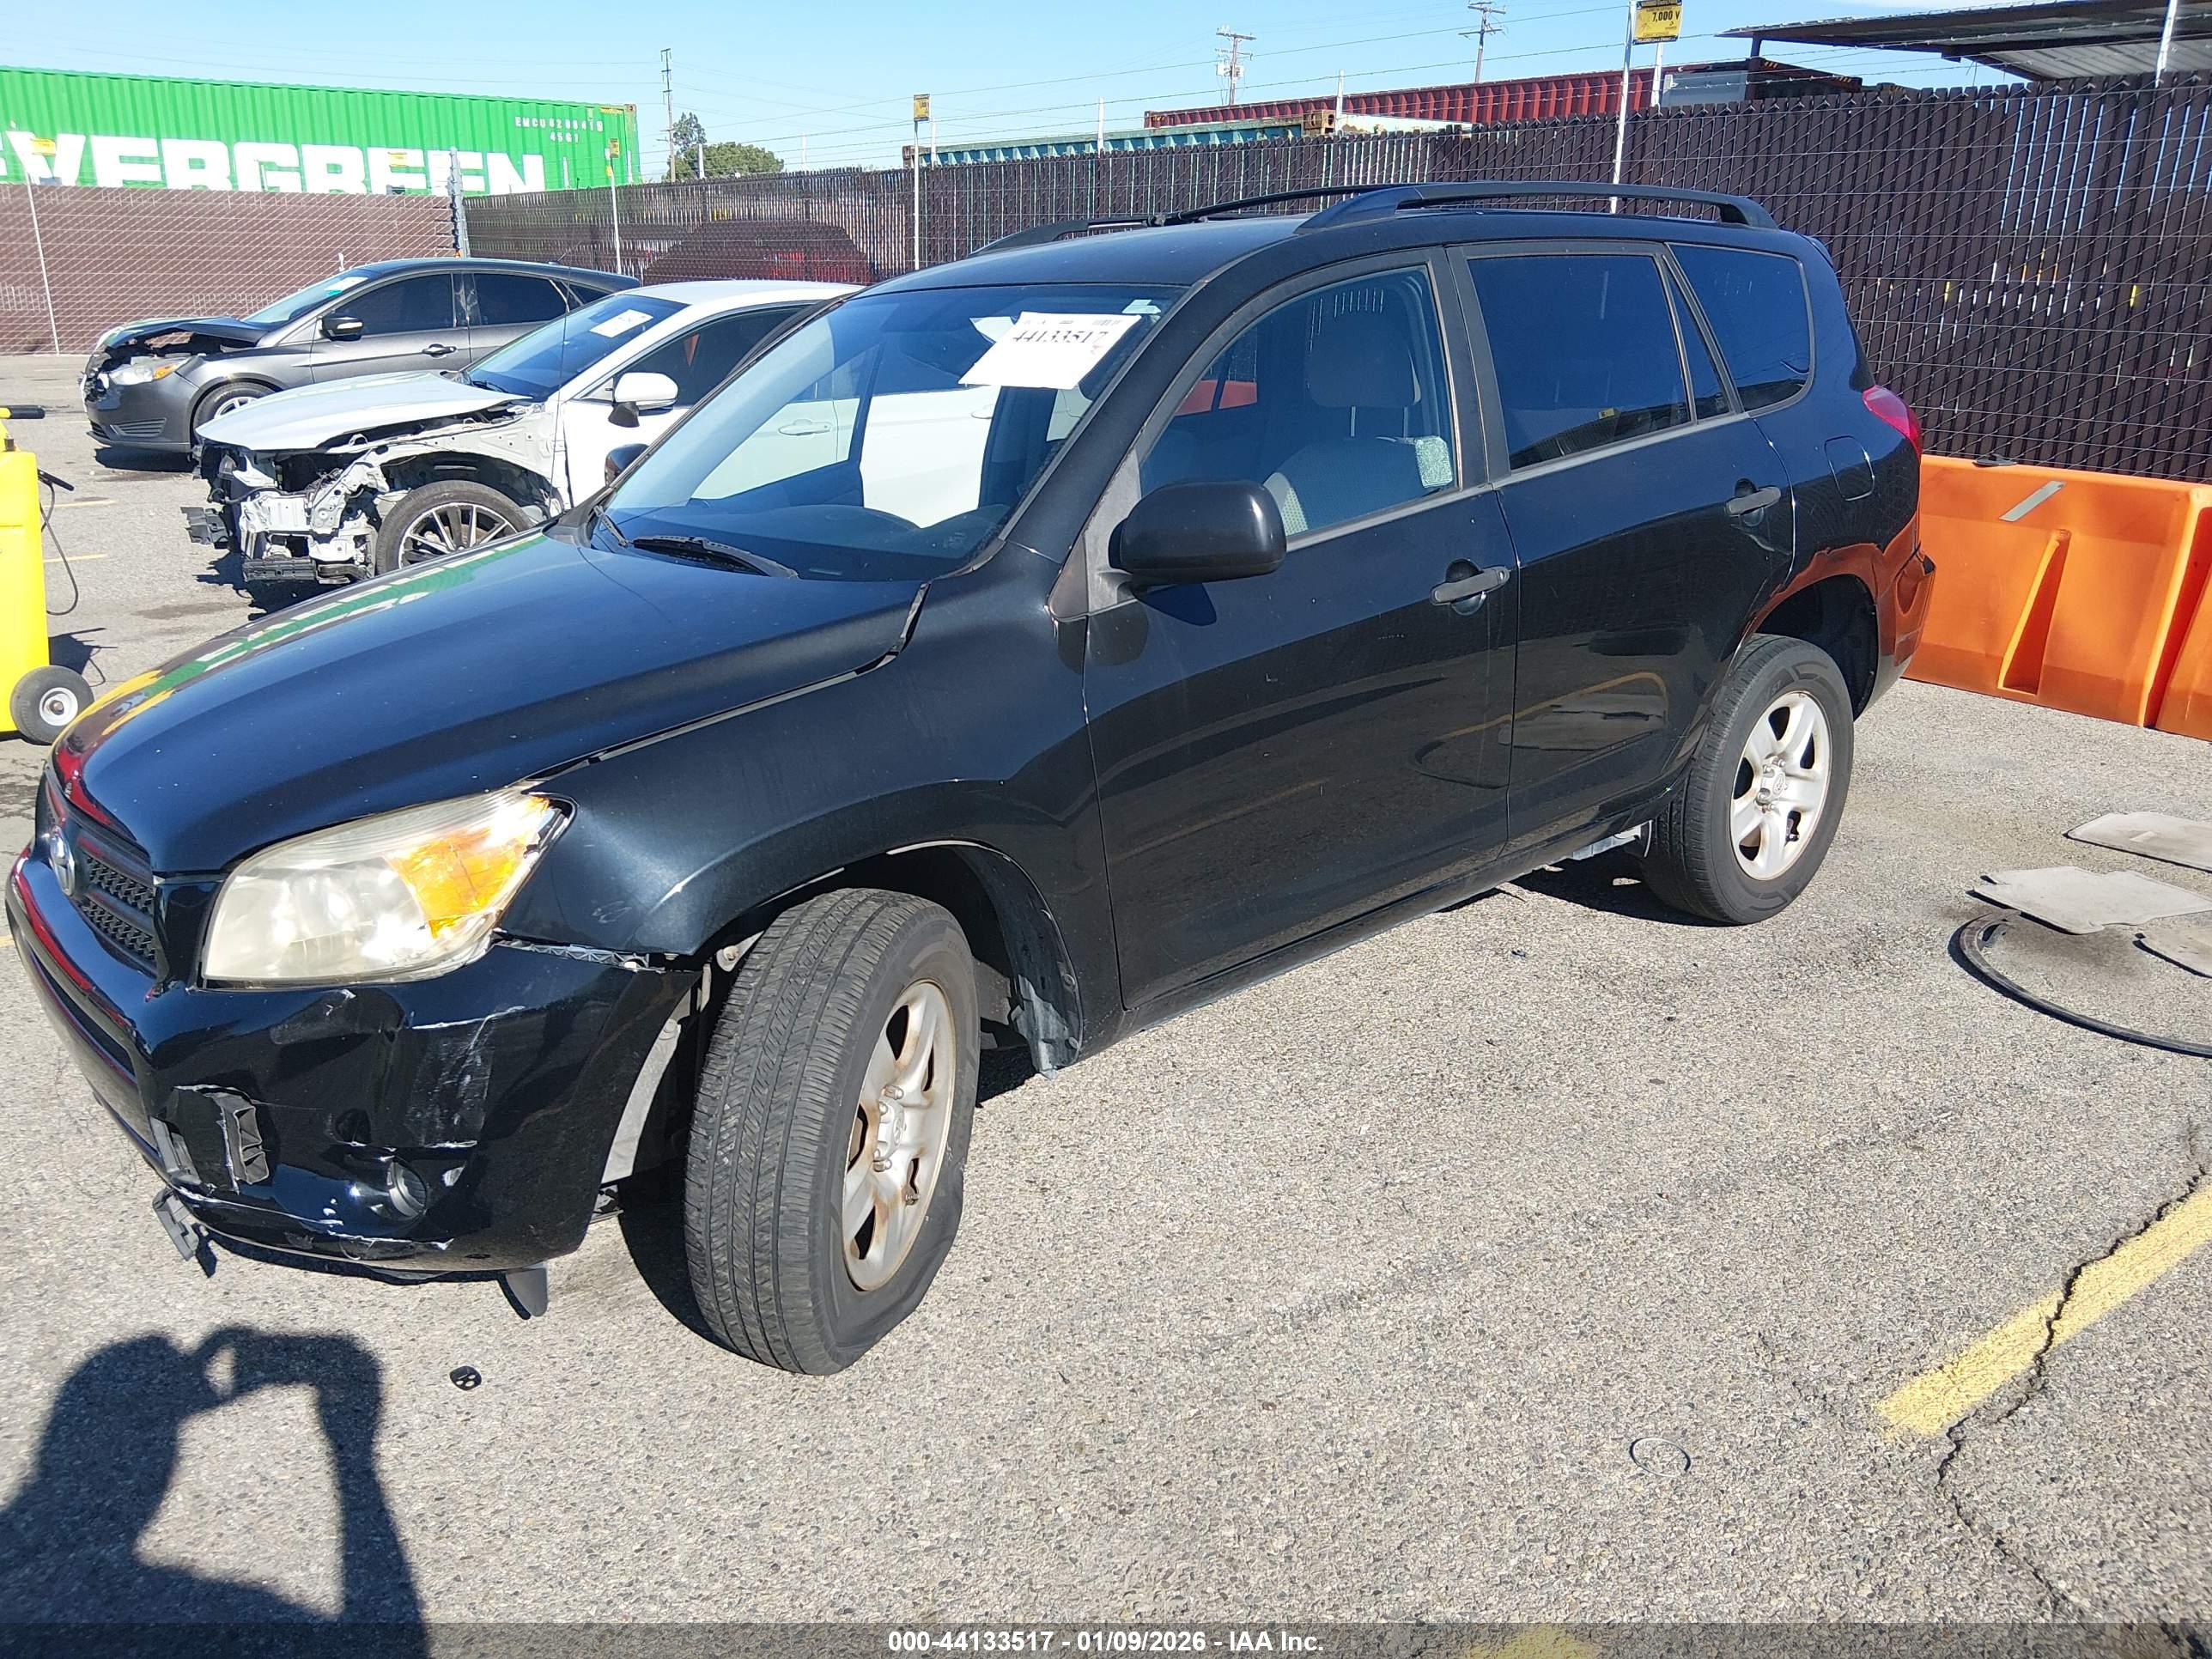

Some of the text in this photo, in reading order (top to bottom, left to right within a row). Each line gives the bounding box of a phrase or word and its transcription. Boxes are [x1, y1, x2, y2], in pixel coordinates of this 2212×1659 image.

[1652, 10, 1673, 22] 7,000
[1675, 9, 1680, 20] V
[0, 131, 545, 197] VERGREEN
